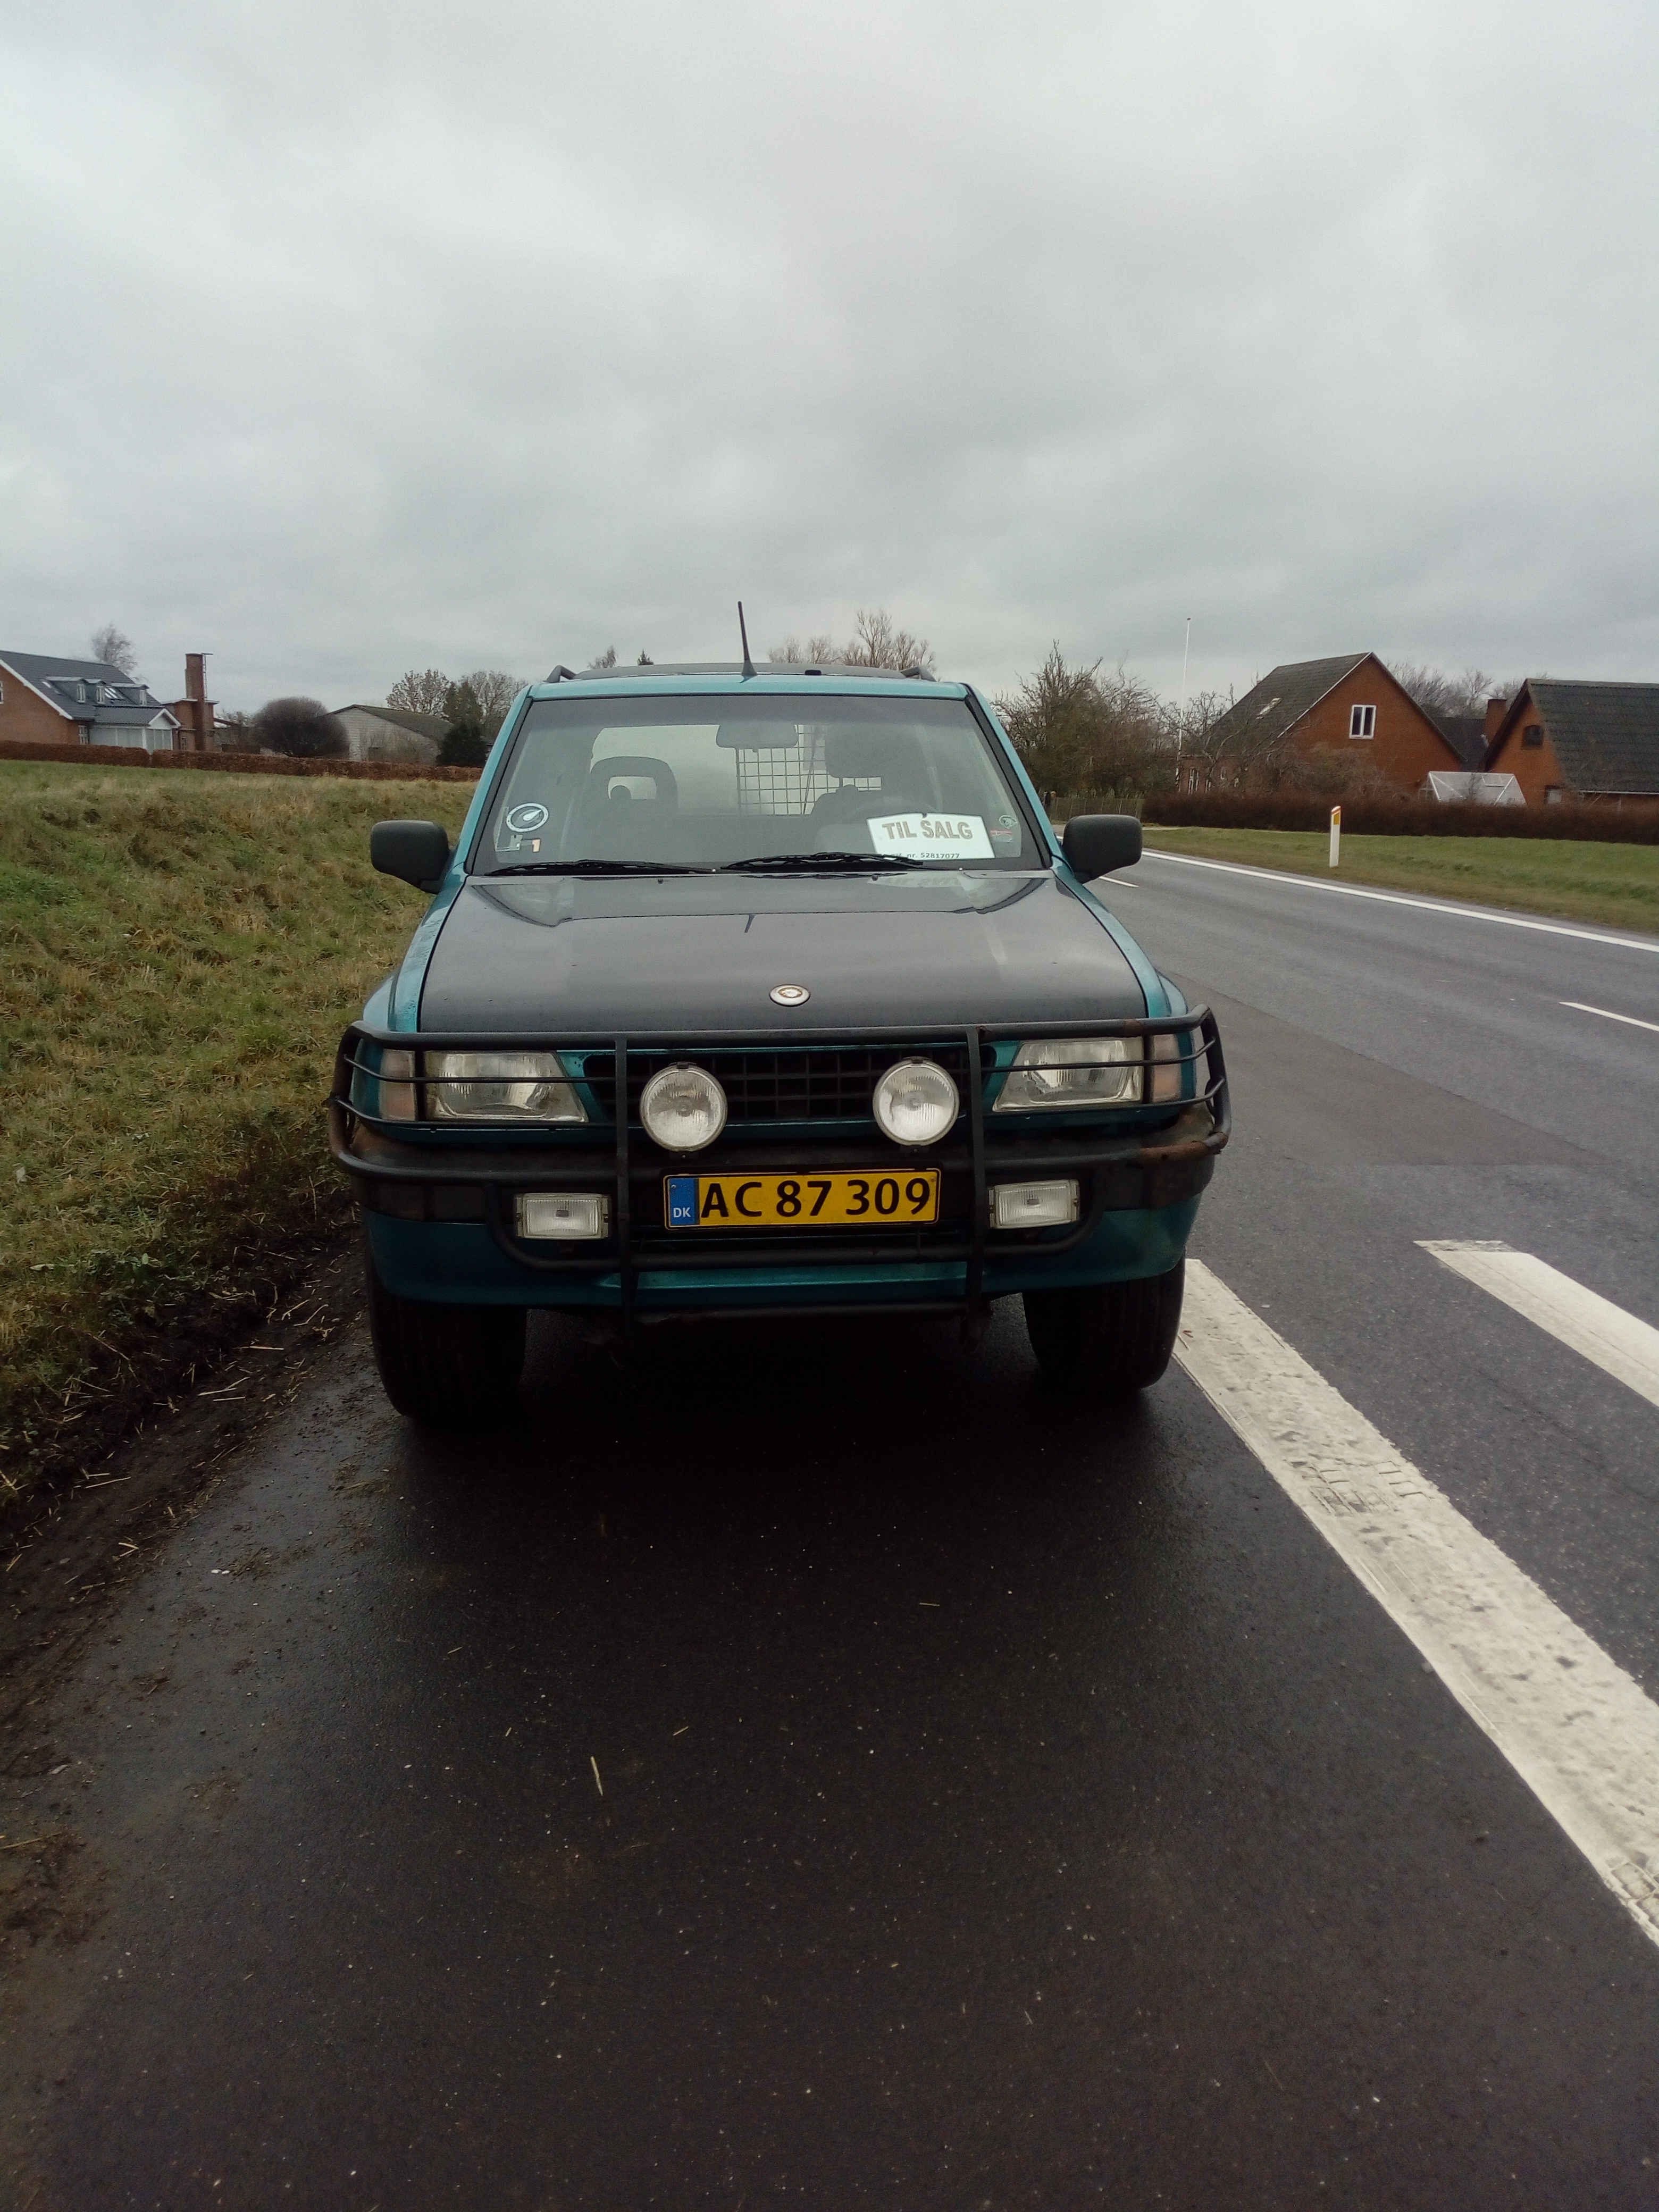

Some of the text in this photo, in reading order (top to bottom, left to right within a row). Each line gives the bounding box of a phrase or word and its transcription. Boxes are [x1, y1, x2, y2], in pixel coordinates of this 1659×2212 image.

[882, 820, 973, 840] TIL SALG
[700, 1177, 931, 1218] AC 87 309
[673, 1207, 691, 1218] DK
